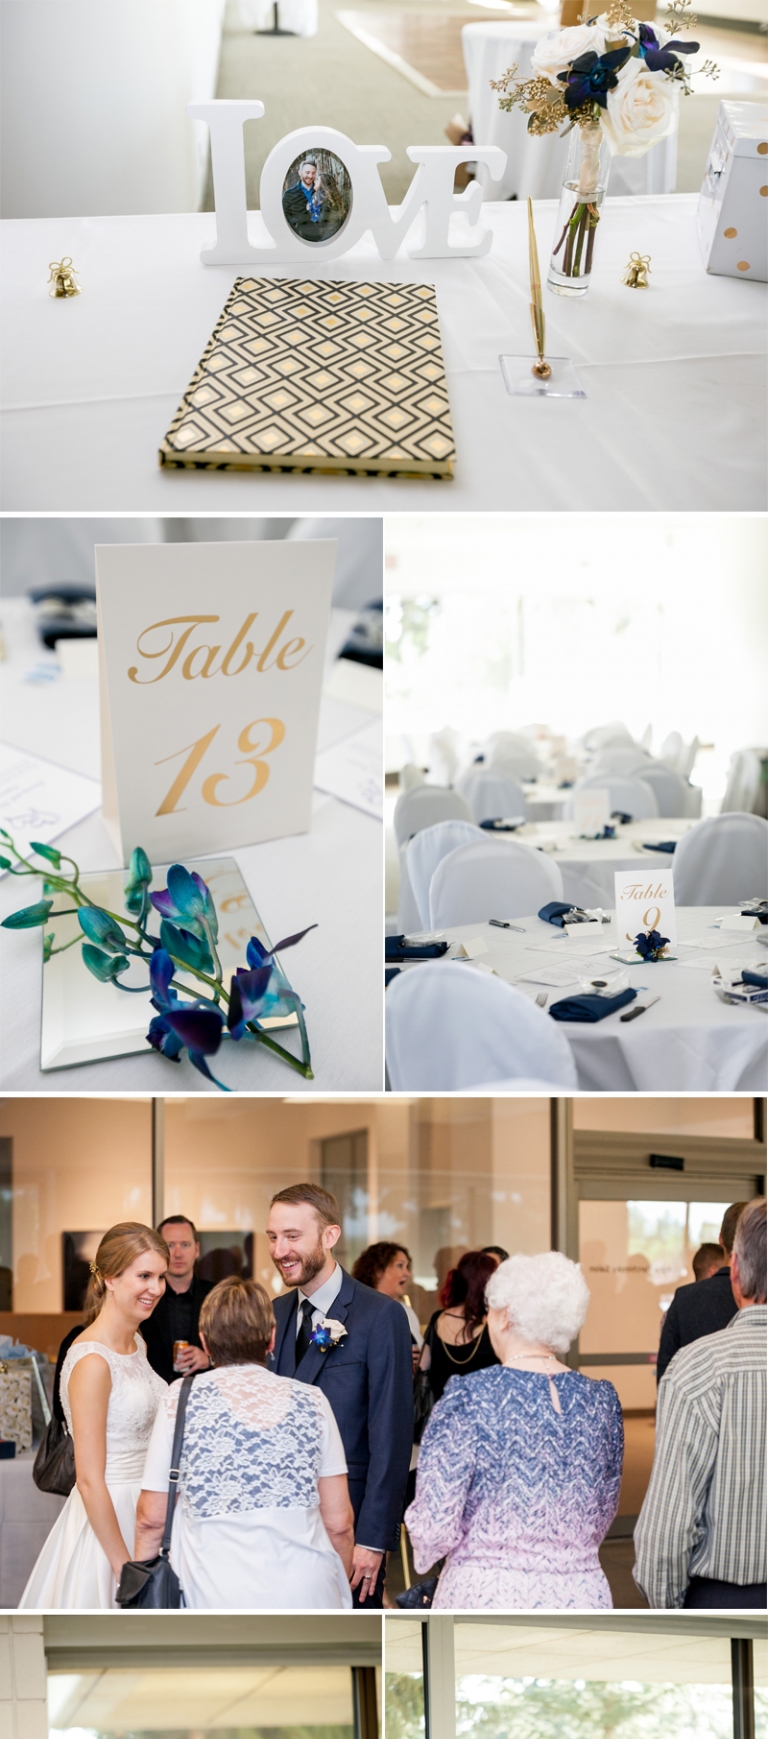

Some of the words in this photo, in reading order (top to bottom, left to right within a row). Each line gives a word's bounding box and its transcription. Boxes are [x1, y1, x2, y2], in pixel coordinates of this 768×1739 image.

[186, 99, 508, 265] LOVE
[127, 609, 314, 684] Table
[154, 717, 286, 818] 13
[621, 883, 669, 901] Table
[626, 906, 661, 941] 9
